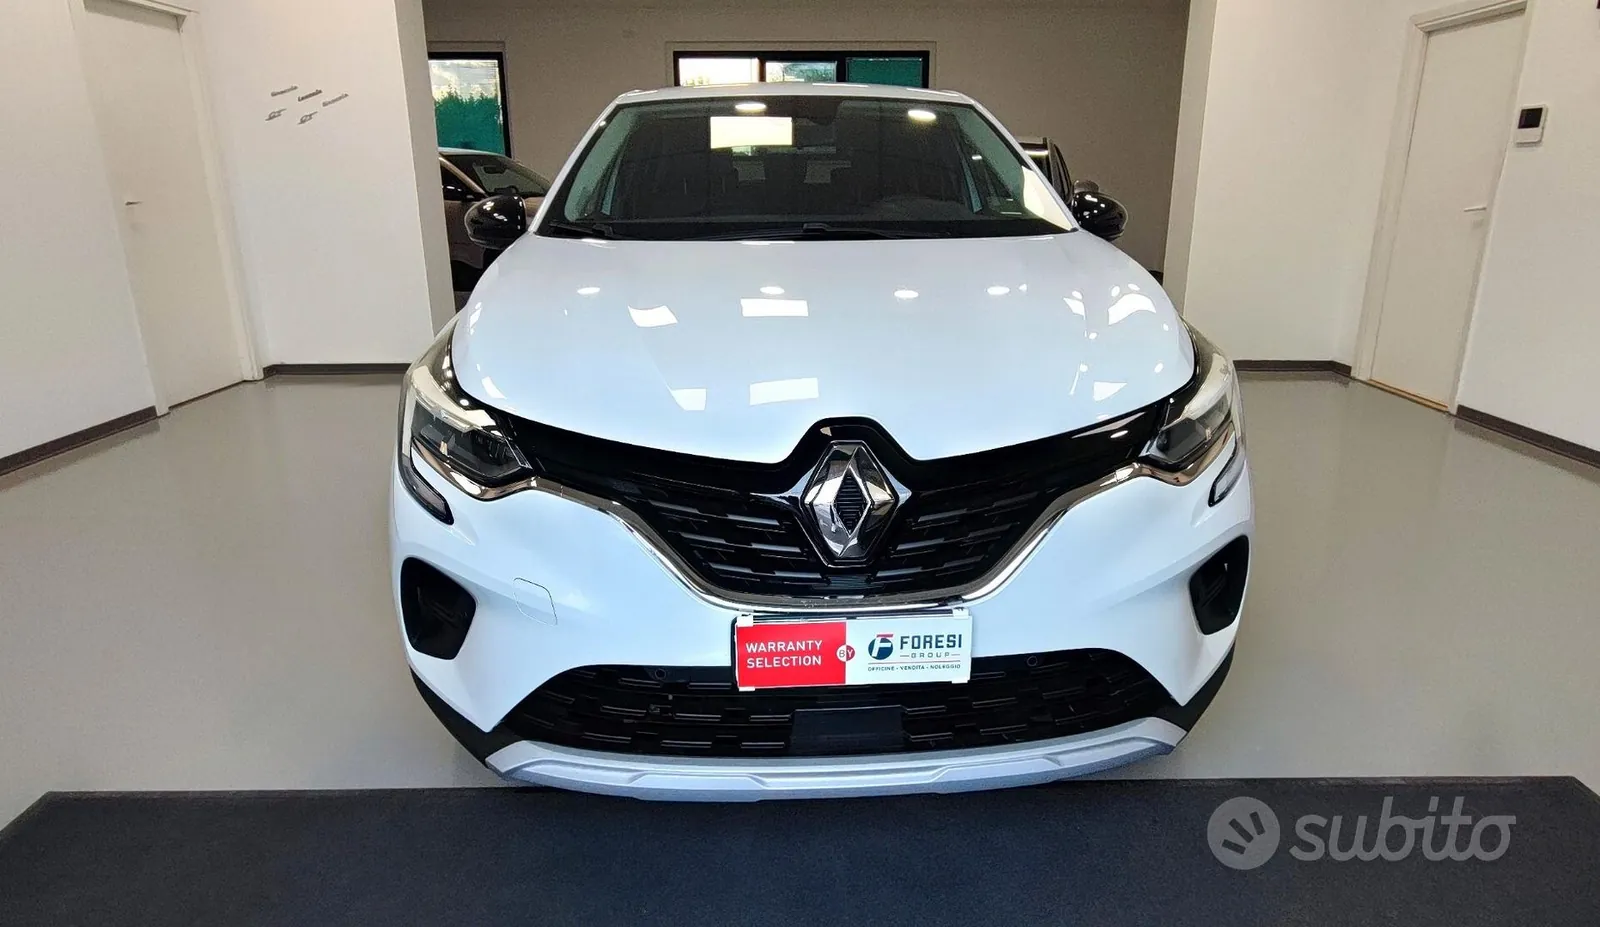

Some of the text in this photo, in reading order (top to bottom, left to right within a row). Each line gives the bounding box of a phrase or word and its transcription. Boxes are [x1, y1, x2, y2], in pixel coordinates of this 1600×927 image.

[745, 640, 823, 653] WARRANTY
[900, 634, 962, 650] FORESI
[838, 649, 853, 657] BY
[746, 656, 822, 669] SELECTION
